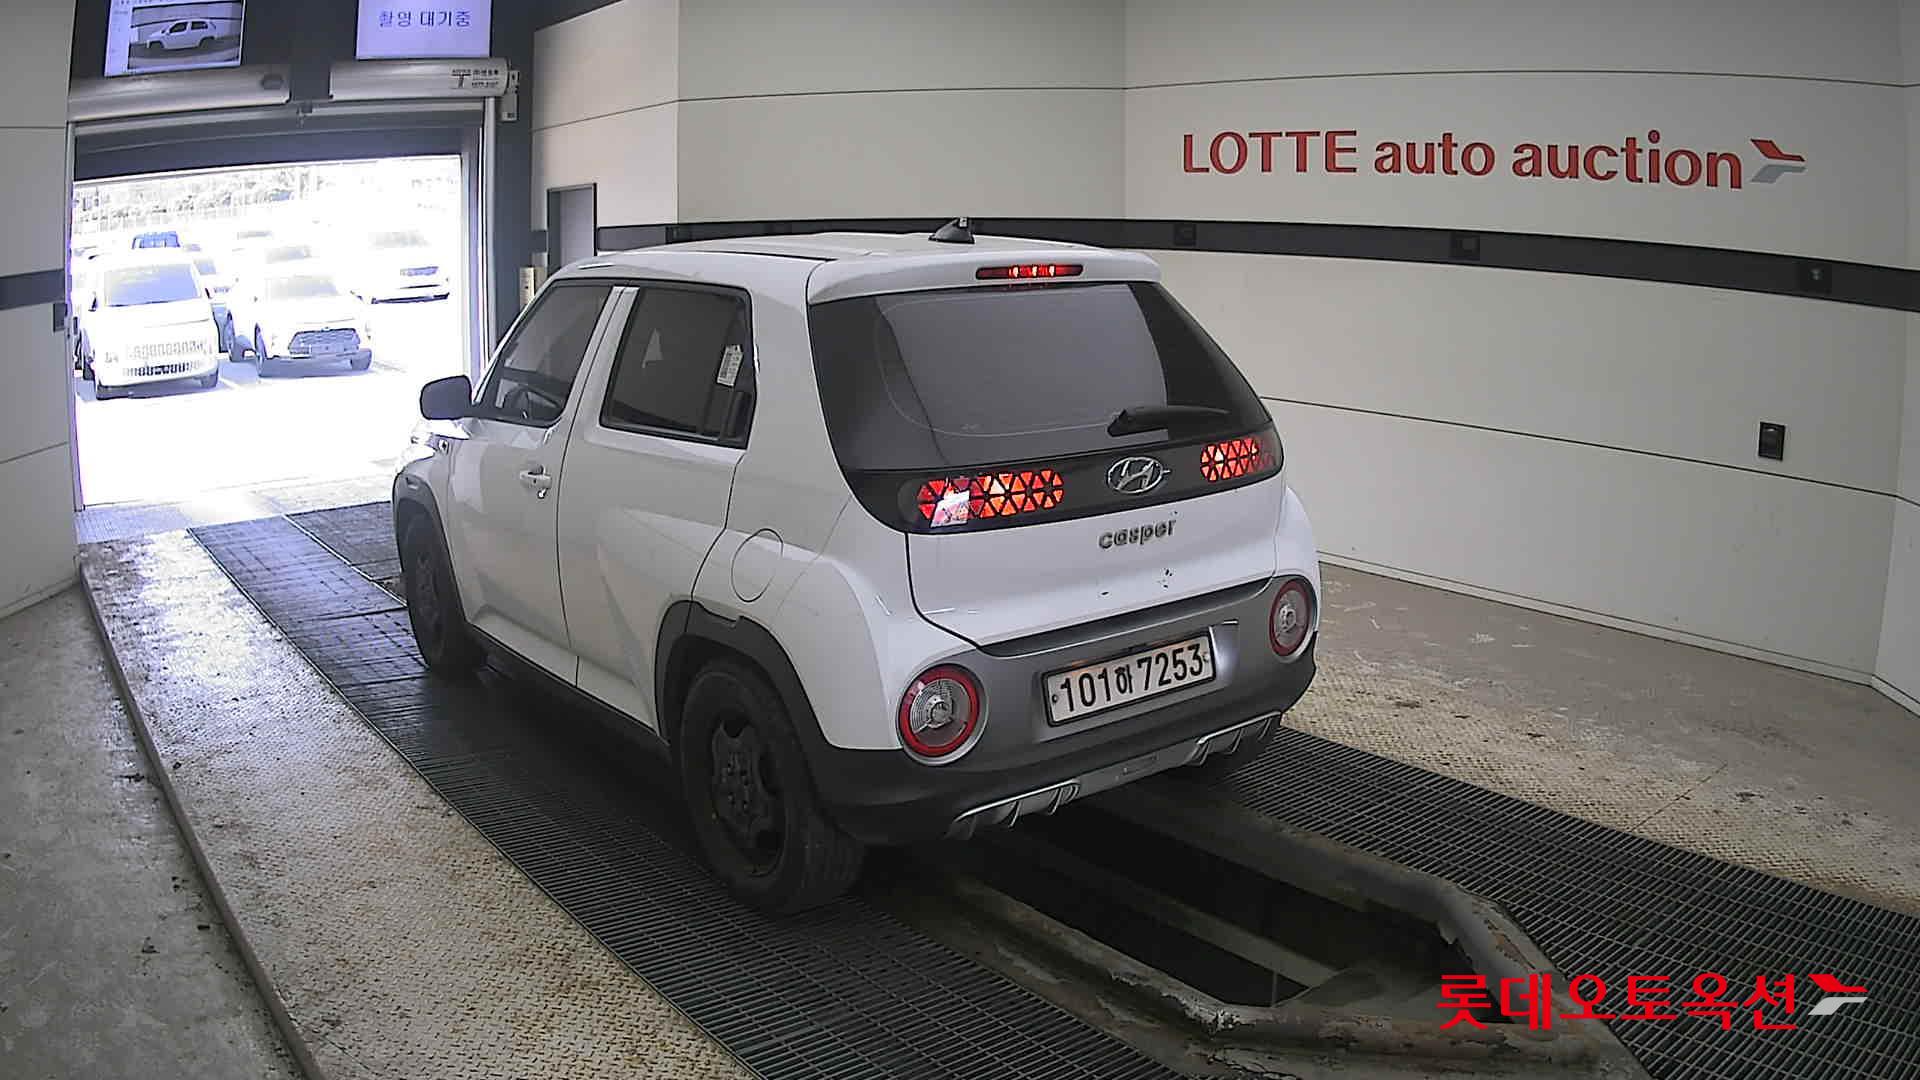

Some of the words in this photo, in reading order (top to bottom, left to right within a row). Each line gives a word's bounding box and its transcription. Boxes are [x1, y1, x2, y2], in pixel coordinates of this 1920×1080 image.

[420, 10, 470, 27] 대기중
[1183, 130, 1357, 174] LOTTE
[1374, 132, 1496, 176] auto
[1511, 129, 1742, 189] auction
[1099, 519, 1176, 549] casper
